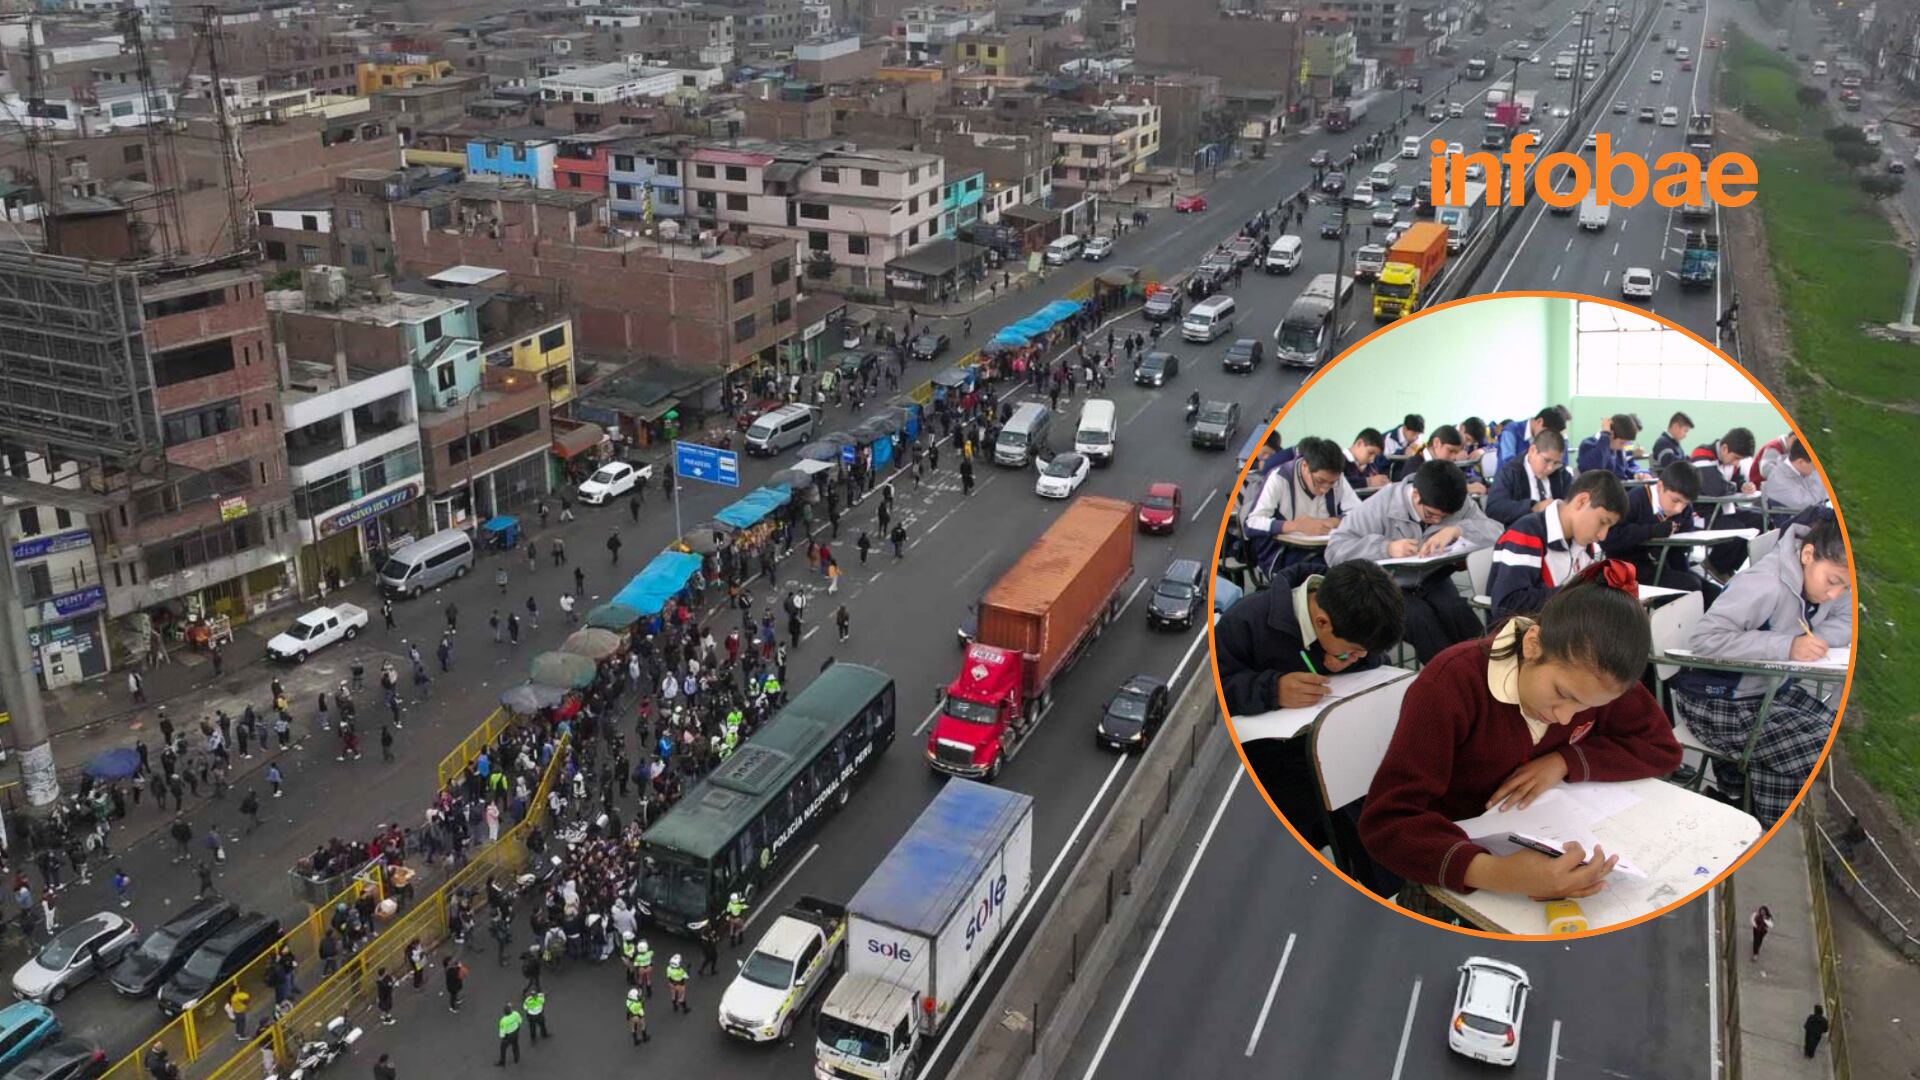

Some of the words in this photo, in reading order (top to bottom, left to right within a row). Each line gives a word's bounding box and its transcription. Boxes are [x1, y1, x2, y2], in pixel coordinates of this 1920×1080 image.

[339, 507, 371, 527] CASINO
[773, 815, 803, 854] POLICÍA
[804, 777, 840, 820] NACIONAL
[841, 763, 854, 782] DEL
[965, 874, 1007, 951] sole
[867, 936, 912, 963] sole
